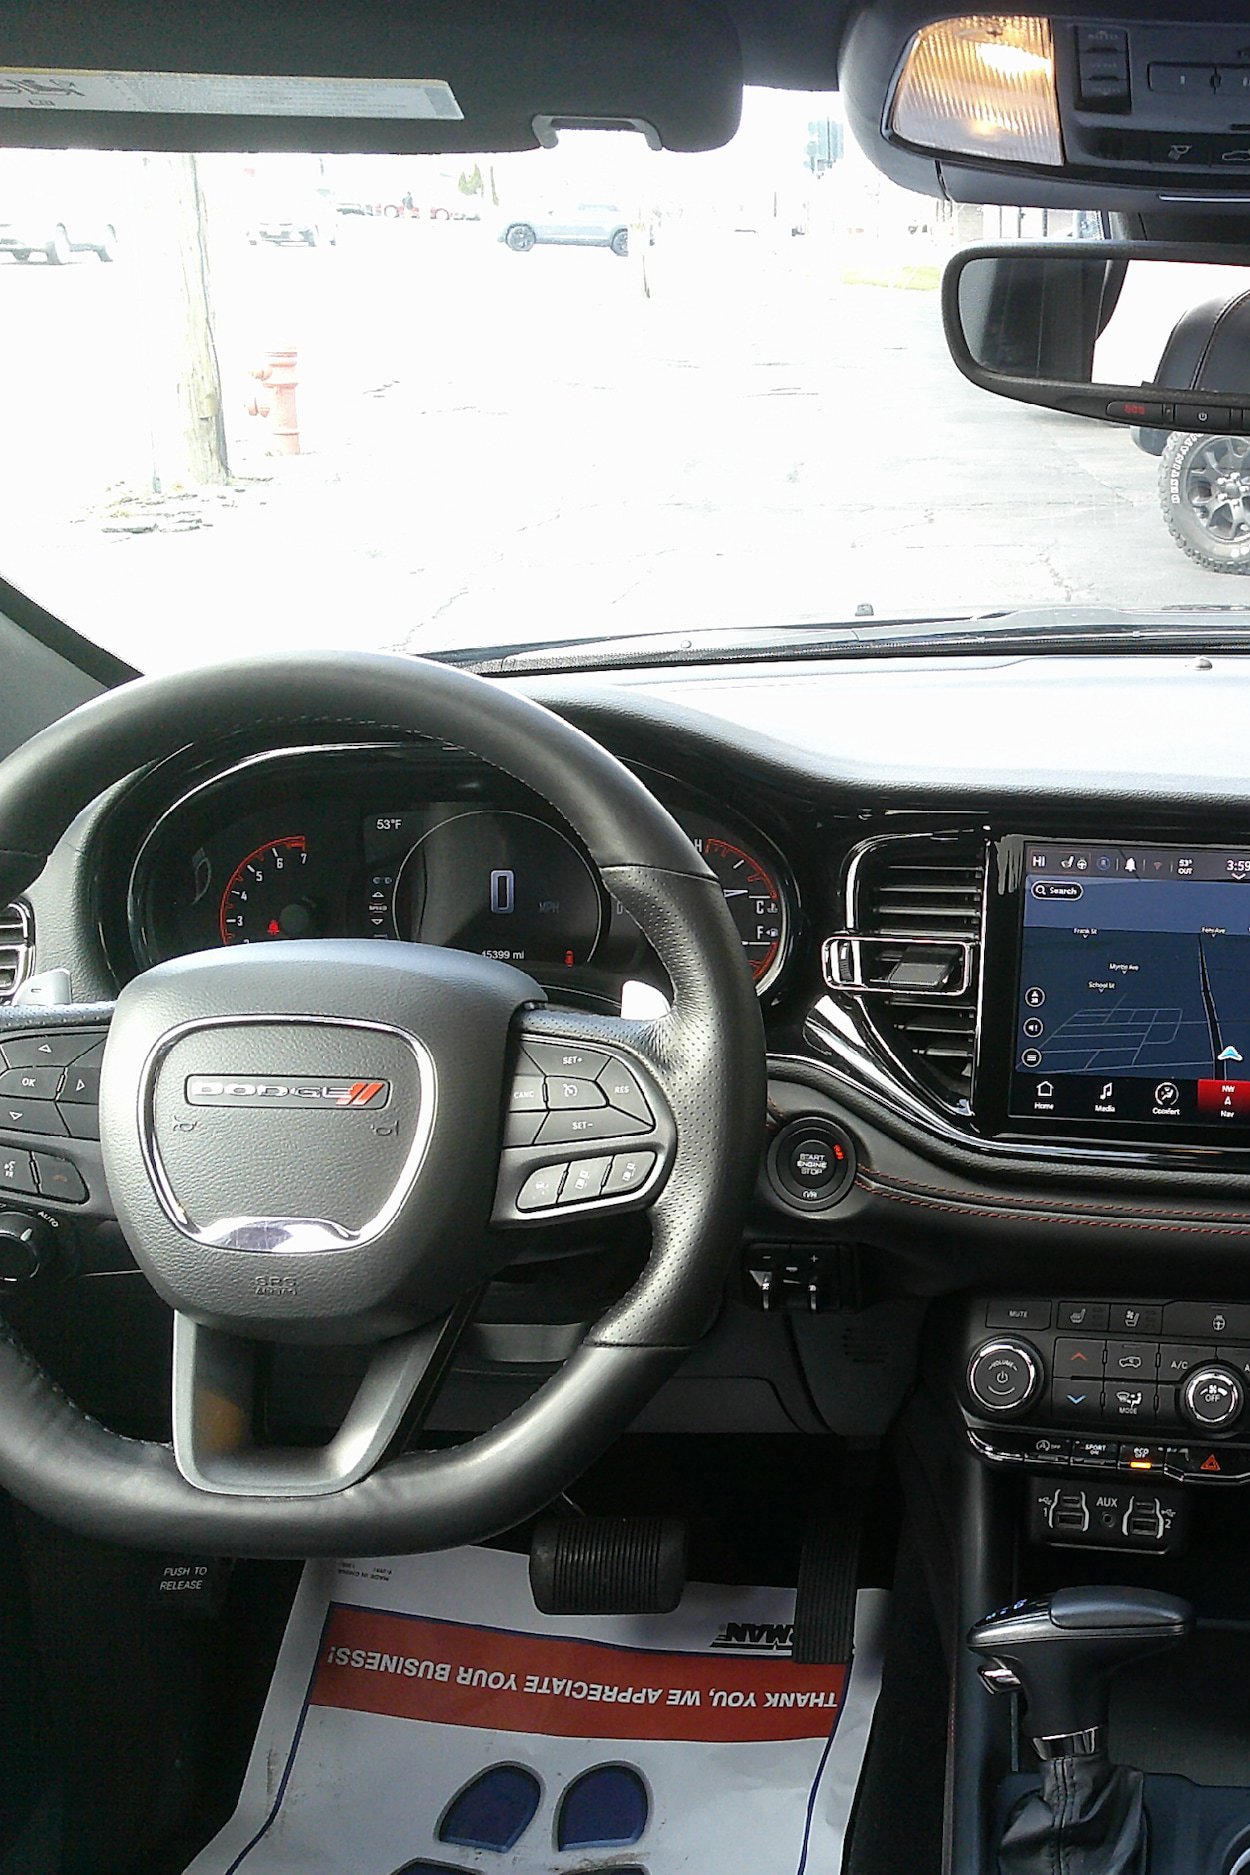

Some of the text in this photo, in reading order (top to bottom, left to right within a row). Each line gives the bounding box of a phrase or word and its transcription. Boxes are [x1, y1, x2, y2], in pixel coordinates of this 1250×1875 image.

[376, 819, 402, 830] 53°F
[694, 839, 703, 853] H
[276, 857, 284, 869] 6
[301, 853, 307, 864] 7
[1032, 856, 1046, 867] HI
[1178, 867, 1193, 875] OUT
[255, 871, 263, 882] 5
[240, 890, 248, 901] 4
[490, 869, 515, 914] 0
[1049, 886, 1077, 895] Search
[539, 901, 560, 913] MPH
[756, 902, 764, 914] C
[236, 915, 243, 926] 3
[756, 926, 764, 939] F
[22, 1078, 36, 1087] OK
[192, 1082, 354, 1100] DODGE
[614, 1086, 630, 1094] RES
[1222, 1085, 1235, 1093] NW
[513, 1090, 534, 1099] CANC
[1034, 1102, 1054, 1110] Home
[1221, 1110, 1235, 1118] Nav
[799, 1153, 826, 1161] START
[796, 1160, 828, 1169] ENGINE
[801, 1167, 823, 1175] STOP
[37, 1209, 60, 1228] AUTO
[1009, 1310, 1028, 1318] MUTE
[991, 1359, 1014, 1369] VOLUME
[1170, 1361, 1188, 1369] A/C
[1204, 1394, 1220, 1402] OFF
[1085, 1443, 1106, 1451] SPORT
[1096, 1498, 1118, 1508] AUX
[1043, 1508, 1048, 1517] 1
[1165, 1519, 1172, 1528] 2
[163, 1566, 208, 1577] PUSH TO
[159, 1580, 203, 1591] RELEASE
[327, 1646, 838, 1708] THANK YOU, WE APPRECIATE YOUR BUSINESS!
